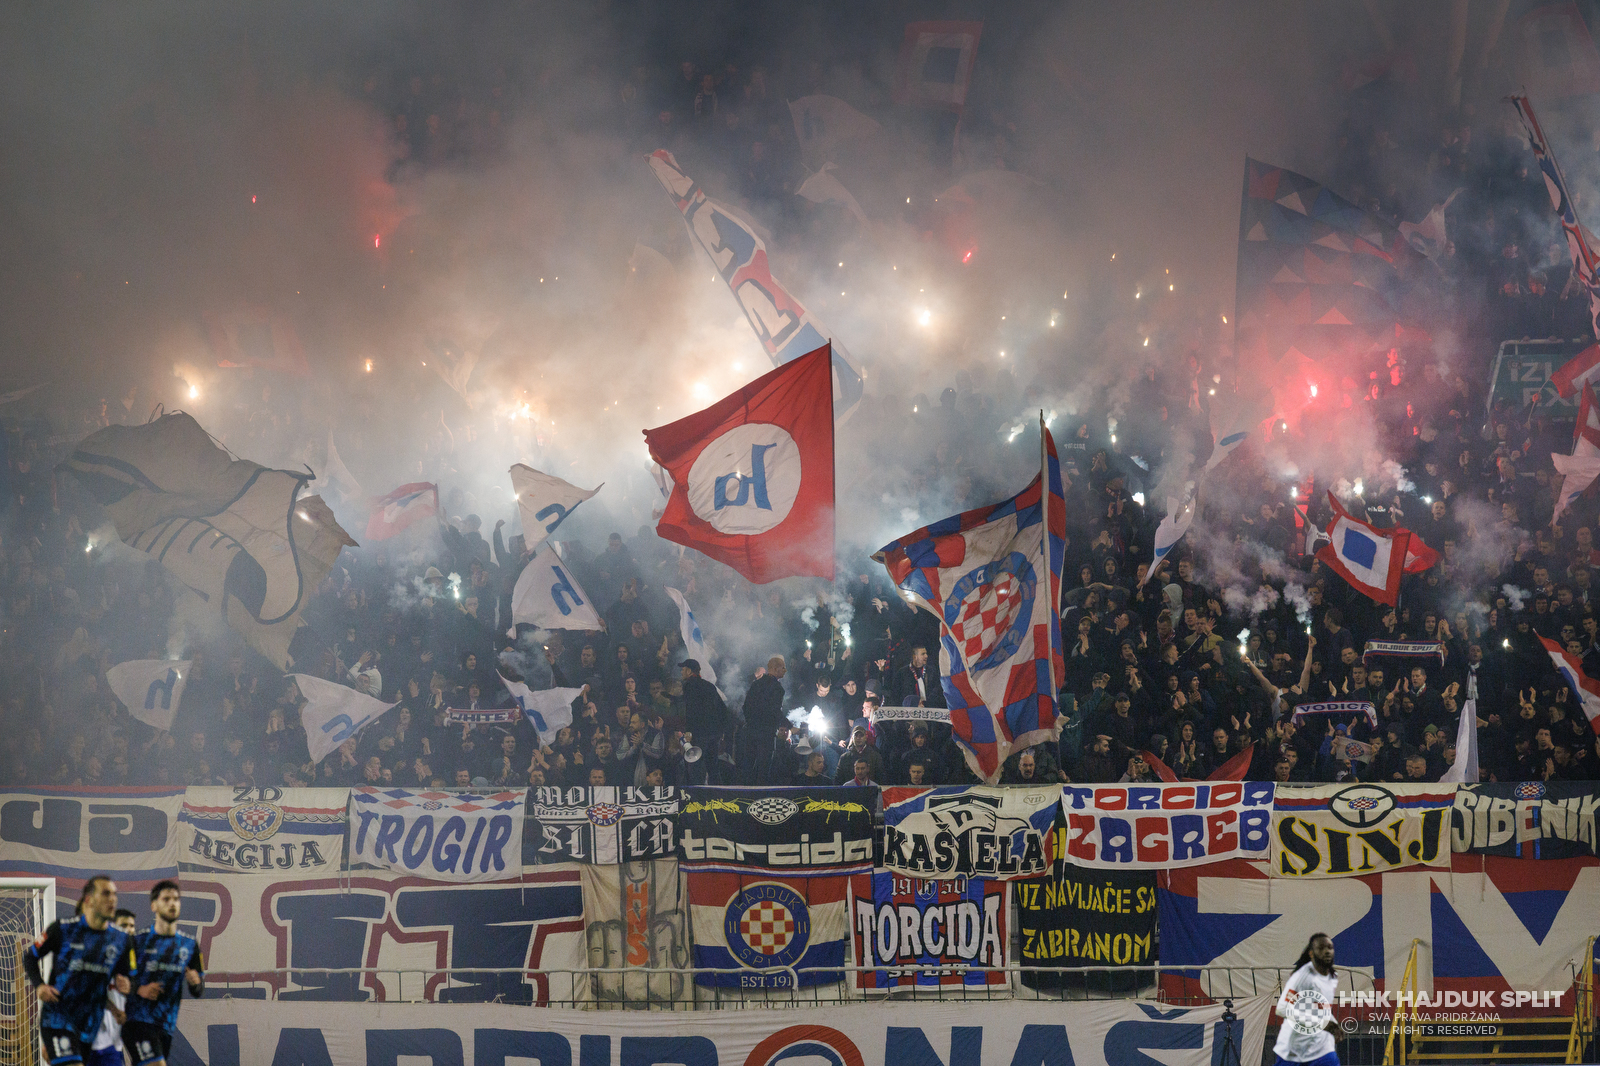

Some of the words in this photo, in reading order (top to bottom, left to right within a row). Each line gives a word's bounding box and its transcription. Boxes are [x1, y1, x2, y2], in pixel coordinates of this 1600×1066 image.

[233, 785, 283, 803] ZD
[1063, 781, 1275, 810] TORCIDA
[241, 822, 268, 832] SPLIT
[592, 815, 618, 826] SPLIT
[756, 812, 788, 822] SPLIT
[1450, 782, 1600, 855] ŠIBENIK
[189, 828, 326, 869] REGIJA
[356, 810, 513, 874] TROGIR
[680, 829, 872, 865] torcida
[1068, 809, 1270, 863] ZAGREB
[1278, 808, 1448, 876] SINJ
[734, 887, 801, 911] HAJDUK
[891, 878, 911, 896] 19
[940, 878, 966, 895] 50
[1018, 883, 1041, 911] UZ
[1045, 880, 1131, 914] NAVIJAČE
[1136, 885, 1156, 914] SA
[856, 893, 1004, 971] TORCIDA
[1022, 927, 1151, 965] ZABRANOM
[741, 976, 770, 988] EST.
